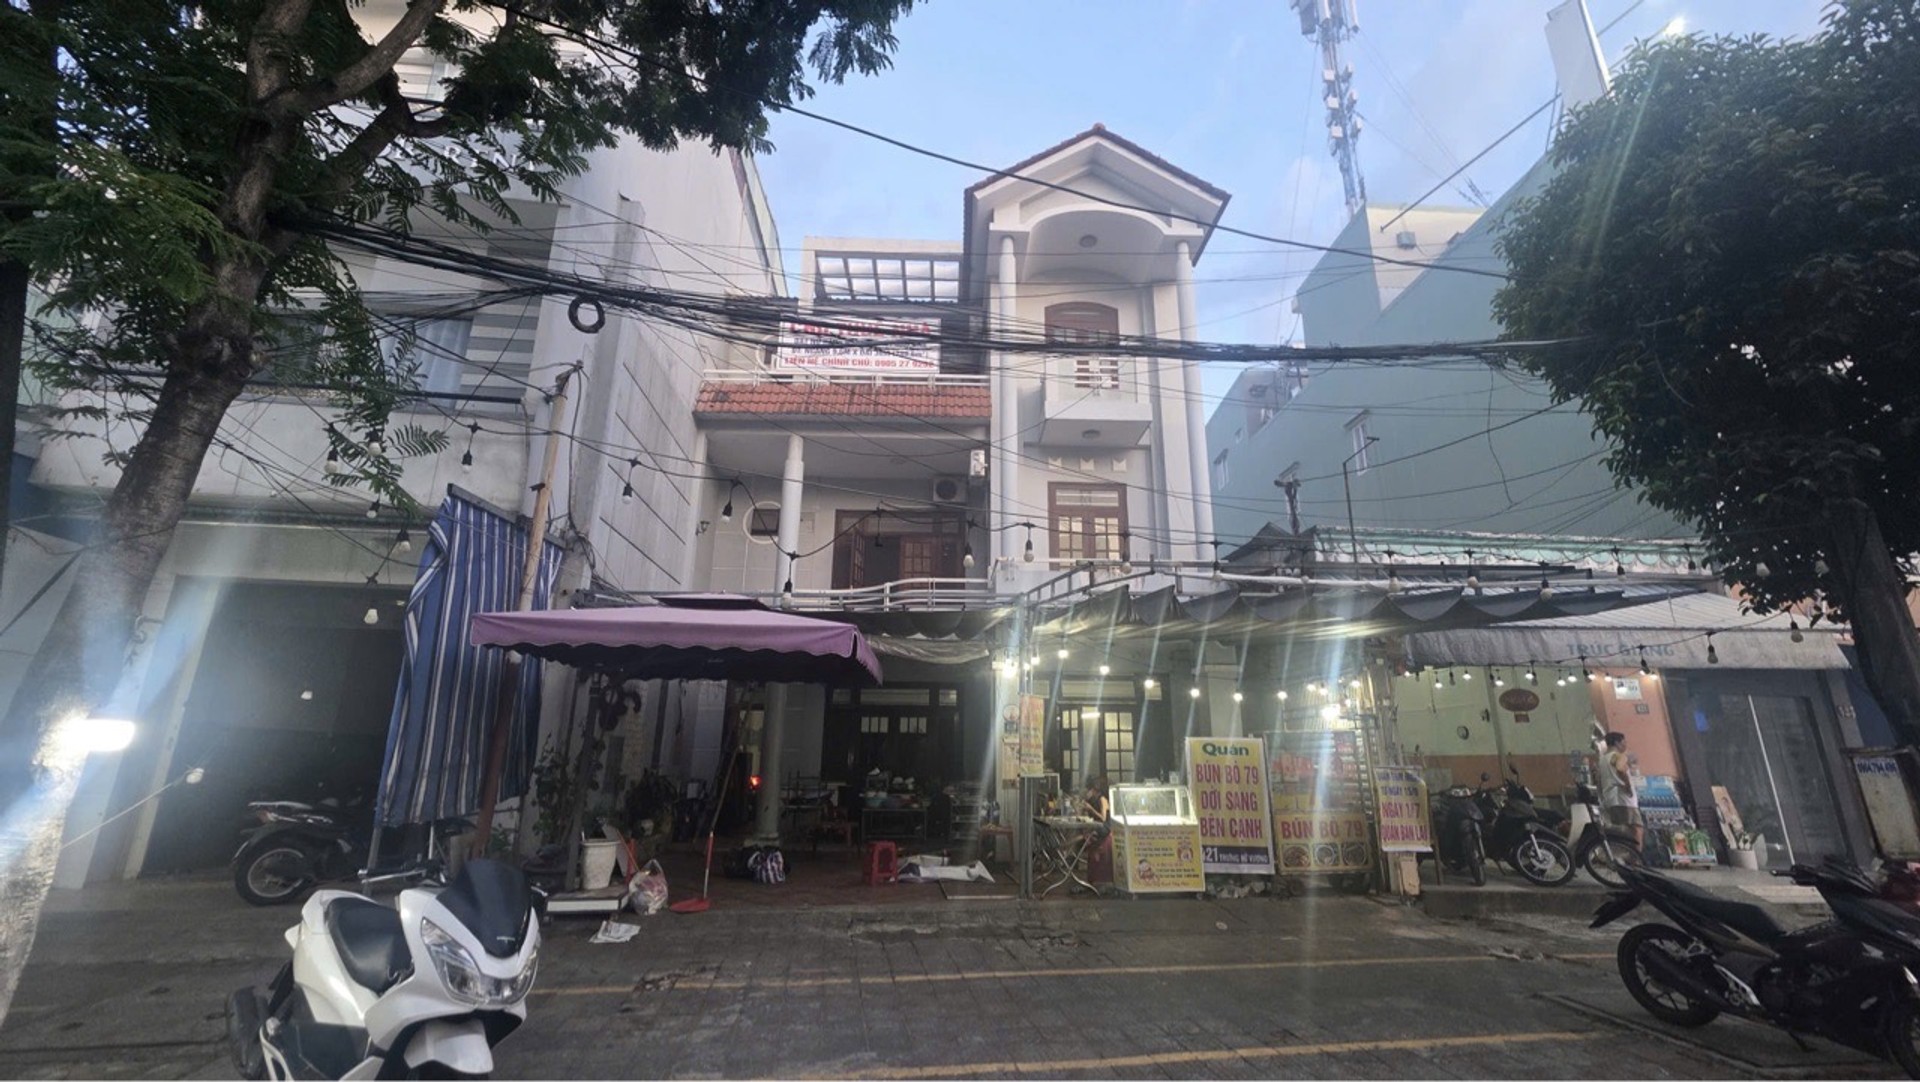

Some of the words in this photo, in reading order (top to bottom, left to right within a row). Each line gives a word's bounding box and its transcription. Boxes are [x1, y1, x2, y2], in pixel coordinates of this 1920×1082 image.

[1202, 742, 1249, 756] Quán
[1196, 760, 1220, 782] BÚN
[1225, 760, 1240, 784] BÒ
[1243, 766, 1259, 785] 79
[1225, 791, 1259, 811] SANG
[1201, 813, 1225, 838] BÊN
[1229, 817, 1262, 843] CẠNH
[1282, 817, 1314, 839] BÚN
[1344, 820, 1363, 838] 79
